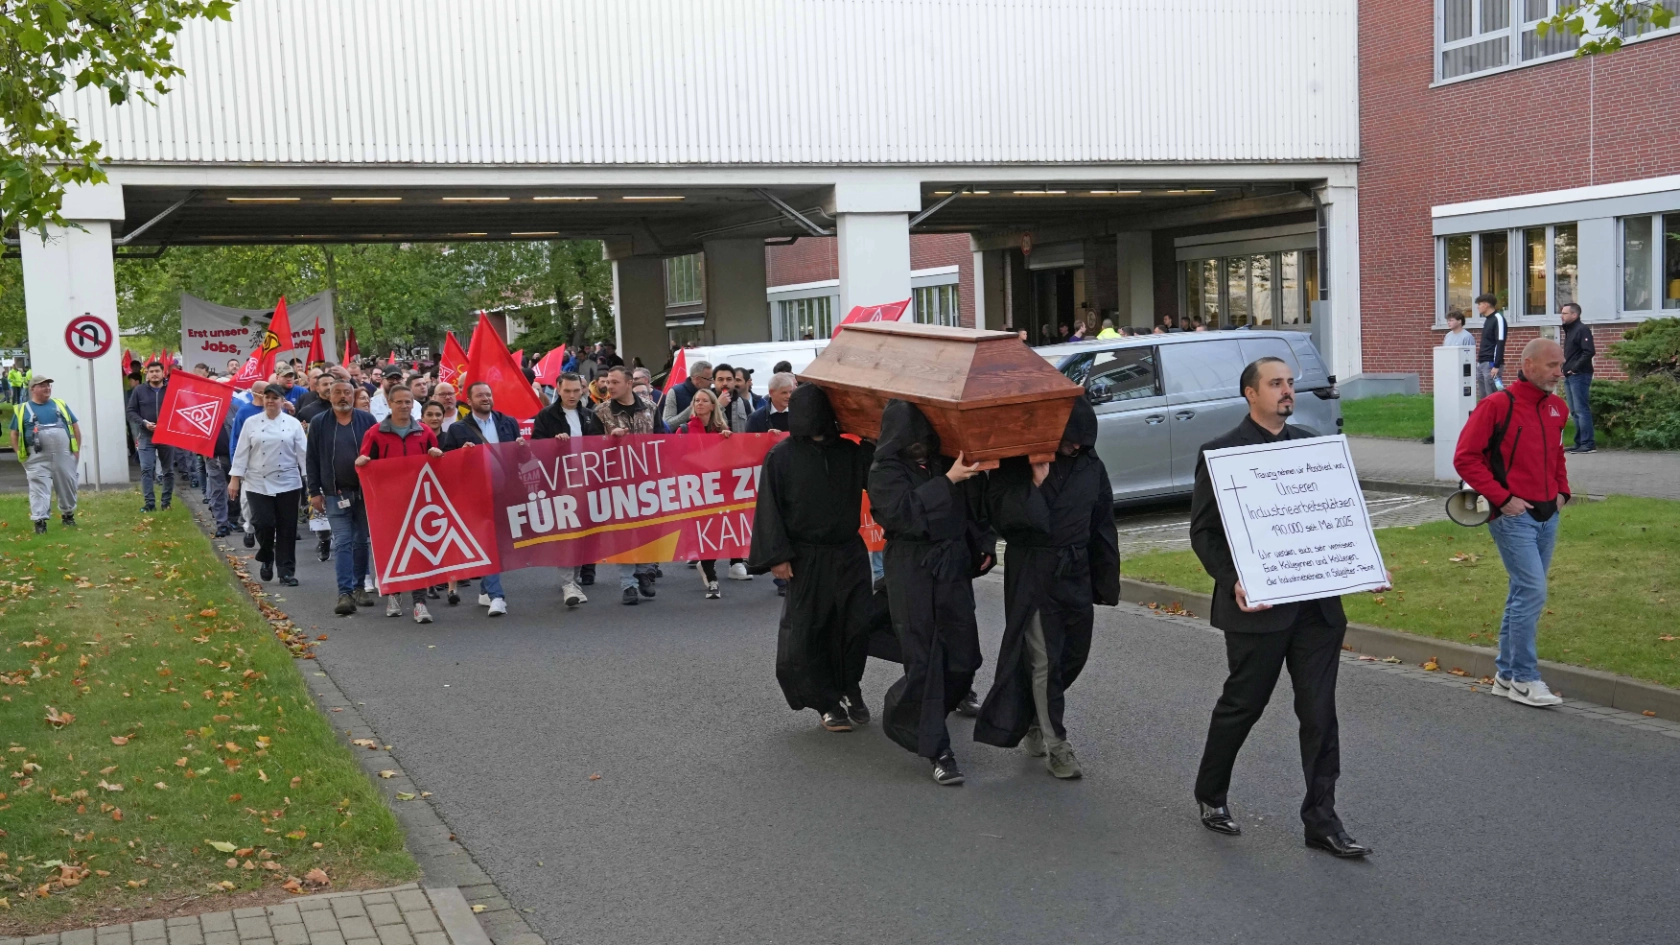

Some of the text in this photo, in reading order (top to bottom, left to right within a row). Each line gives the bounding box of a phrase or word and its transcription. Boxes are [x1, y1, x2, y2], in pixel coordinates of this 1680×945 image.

[188, 328, 208, 338] Erst
[209, 327, 249, 338] unsere
[302, 328, 325, 337] eue
[201, 340, 241, 355] Jobs,
[538, 439, 665, 491] VEREINT
[1275, 481, 1319, 496] Unseren
[506, 489, 582, 539] FÜR
[586, 471, 725, 524] UNSERE
[1271, 515, 1354, 537] 190.000 seit Mai 2025
[1258, 549, 1271, 560] Wir
